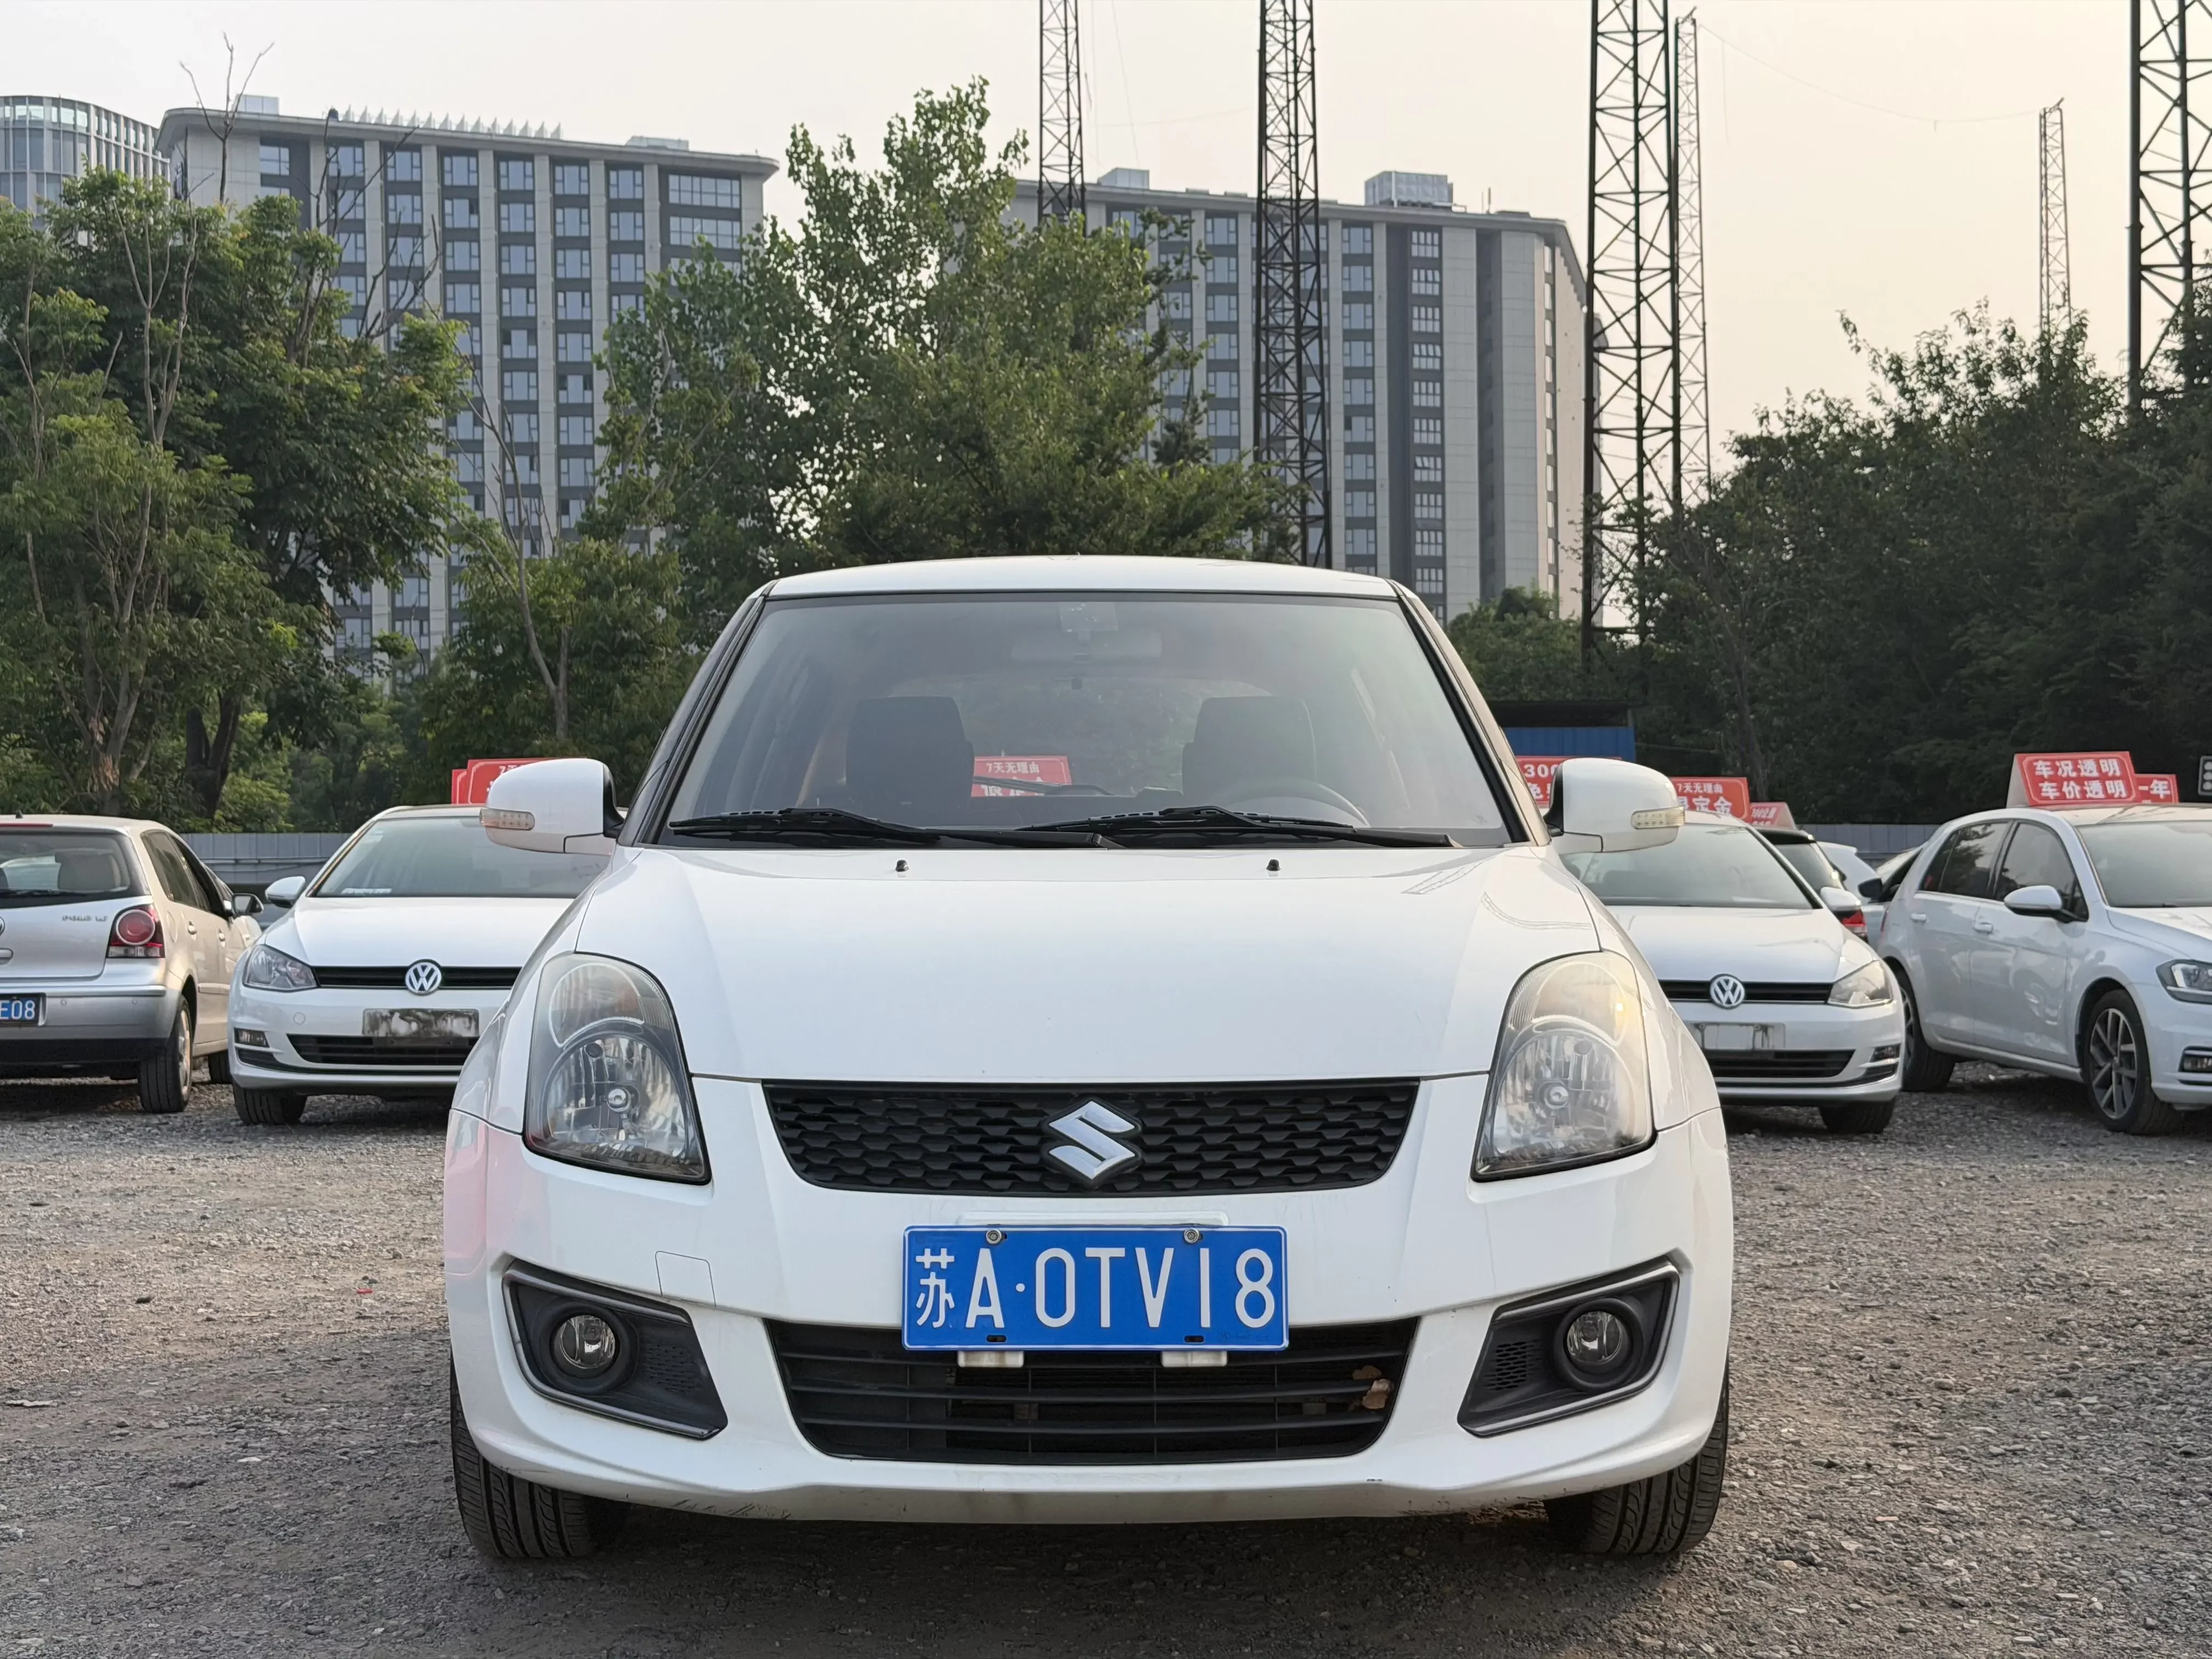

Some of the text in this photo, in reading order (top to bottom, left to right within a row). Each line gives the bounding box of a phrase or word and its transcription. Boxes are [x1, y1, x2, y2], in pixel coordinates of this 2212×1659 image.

[986, 761, 1039, 774] 7天无理由
[2033, 758, 2121, 778] 车况透明
[1677, 782, 1723, 794] 7天无理由
[2039, 780, 2127, 799] 车价透明
[2138, 779, 2170, 799] 一年
[0, 1000, 35, 1019] E08
